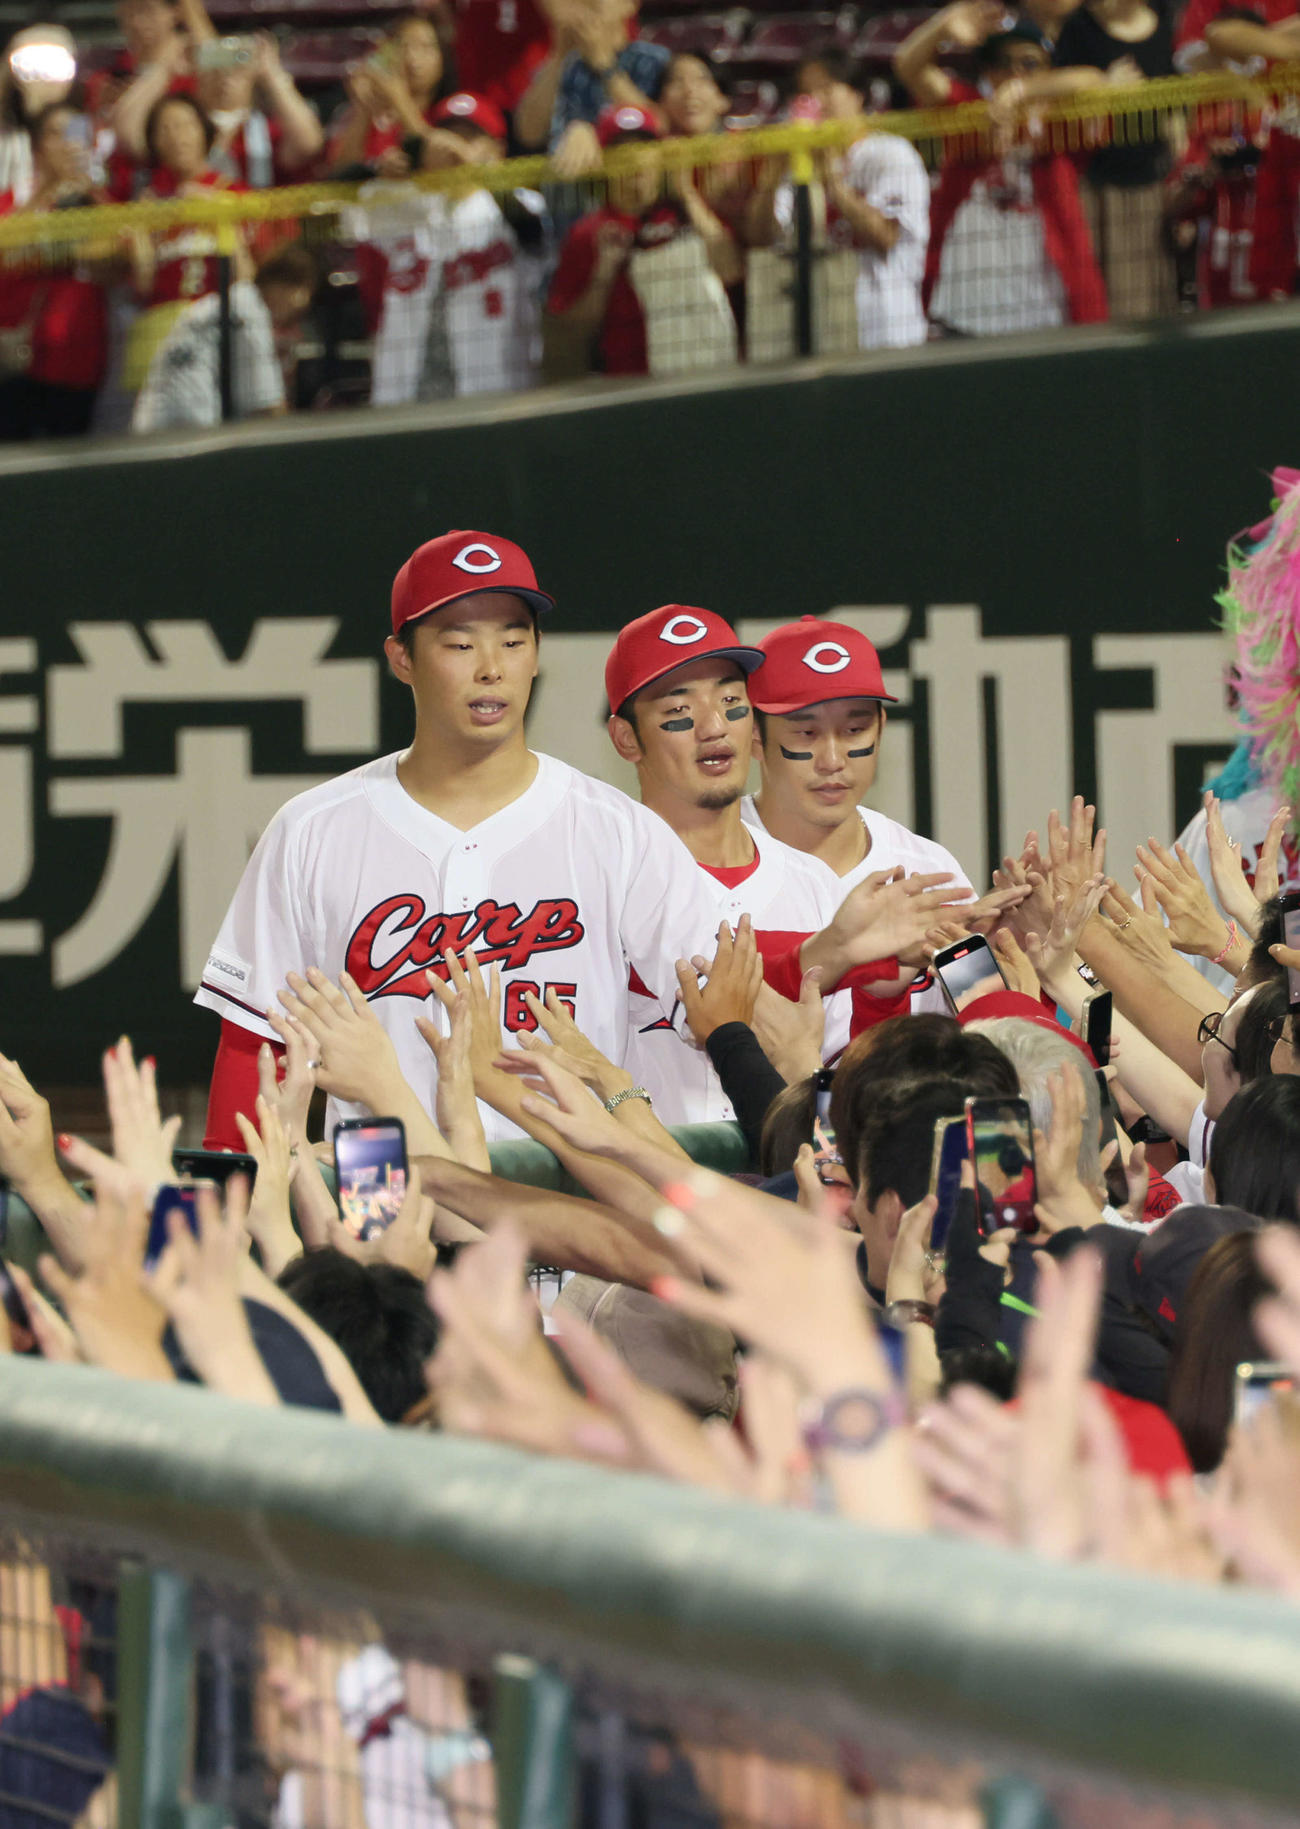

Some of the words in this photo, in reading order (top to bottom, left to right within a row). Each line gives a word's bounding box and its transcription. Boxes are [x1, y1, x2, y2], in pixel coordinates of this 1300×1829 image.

[452, 543, 502, 575] C
[658, 615, 708, 646] C
[801, 641, 851, 674] C
[345, 893, 585, 1002] Carp
[504, 980, 577, 1034] 65
